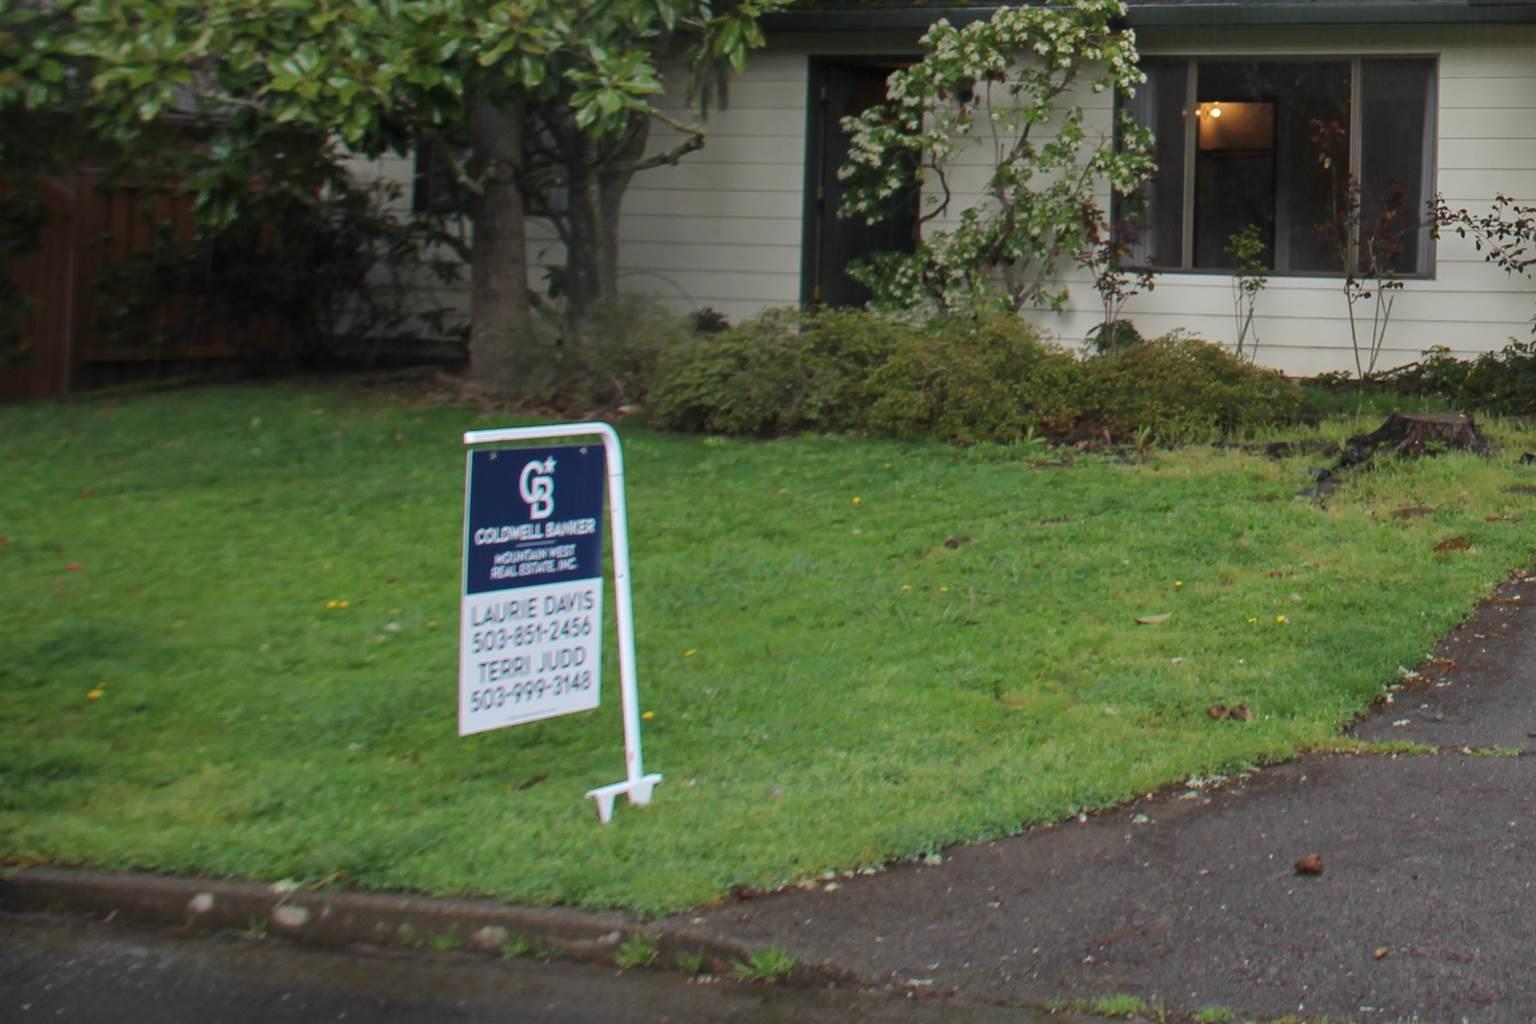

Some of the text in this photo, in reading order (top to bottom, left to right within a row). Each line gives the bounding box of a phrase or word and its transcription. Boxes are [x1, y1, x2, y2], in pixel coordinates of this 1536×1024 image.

[474, 517, 596, 546] COLDWELL BANKER
[490, 564, 518, 579] REAL
[494, 543, 576, 564] MOUNTAIN WEST
[471, 590, 593, 627] LAURIE DAVIS
[471, 616, 593, 654] 503-851-2456
[478, 646, 586, 683] TERRI JUDD
[469, 669, 593, 713] 503-999-3148
